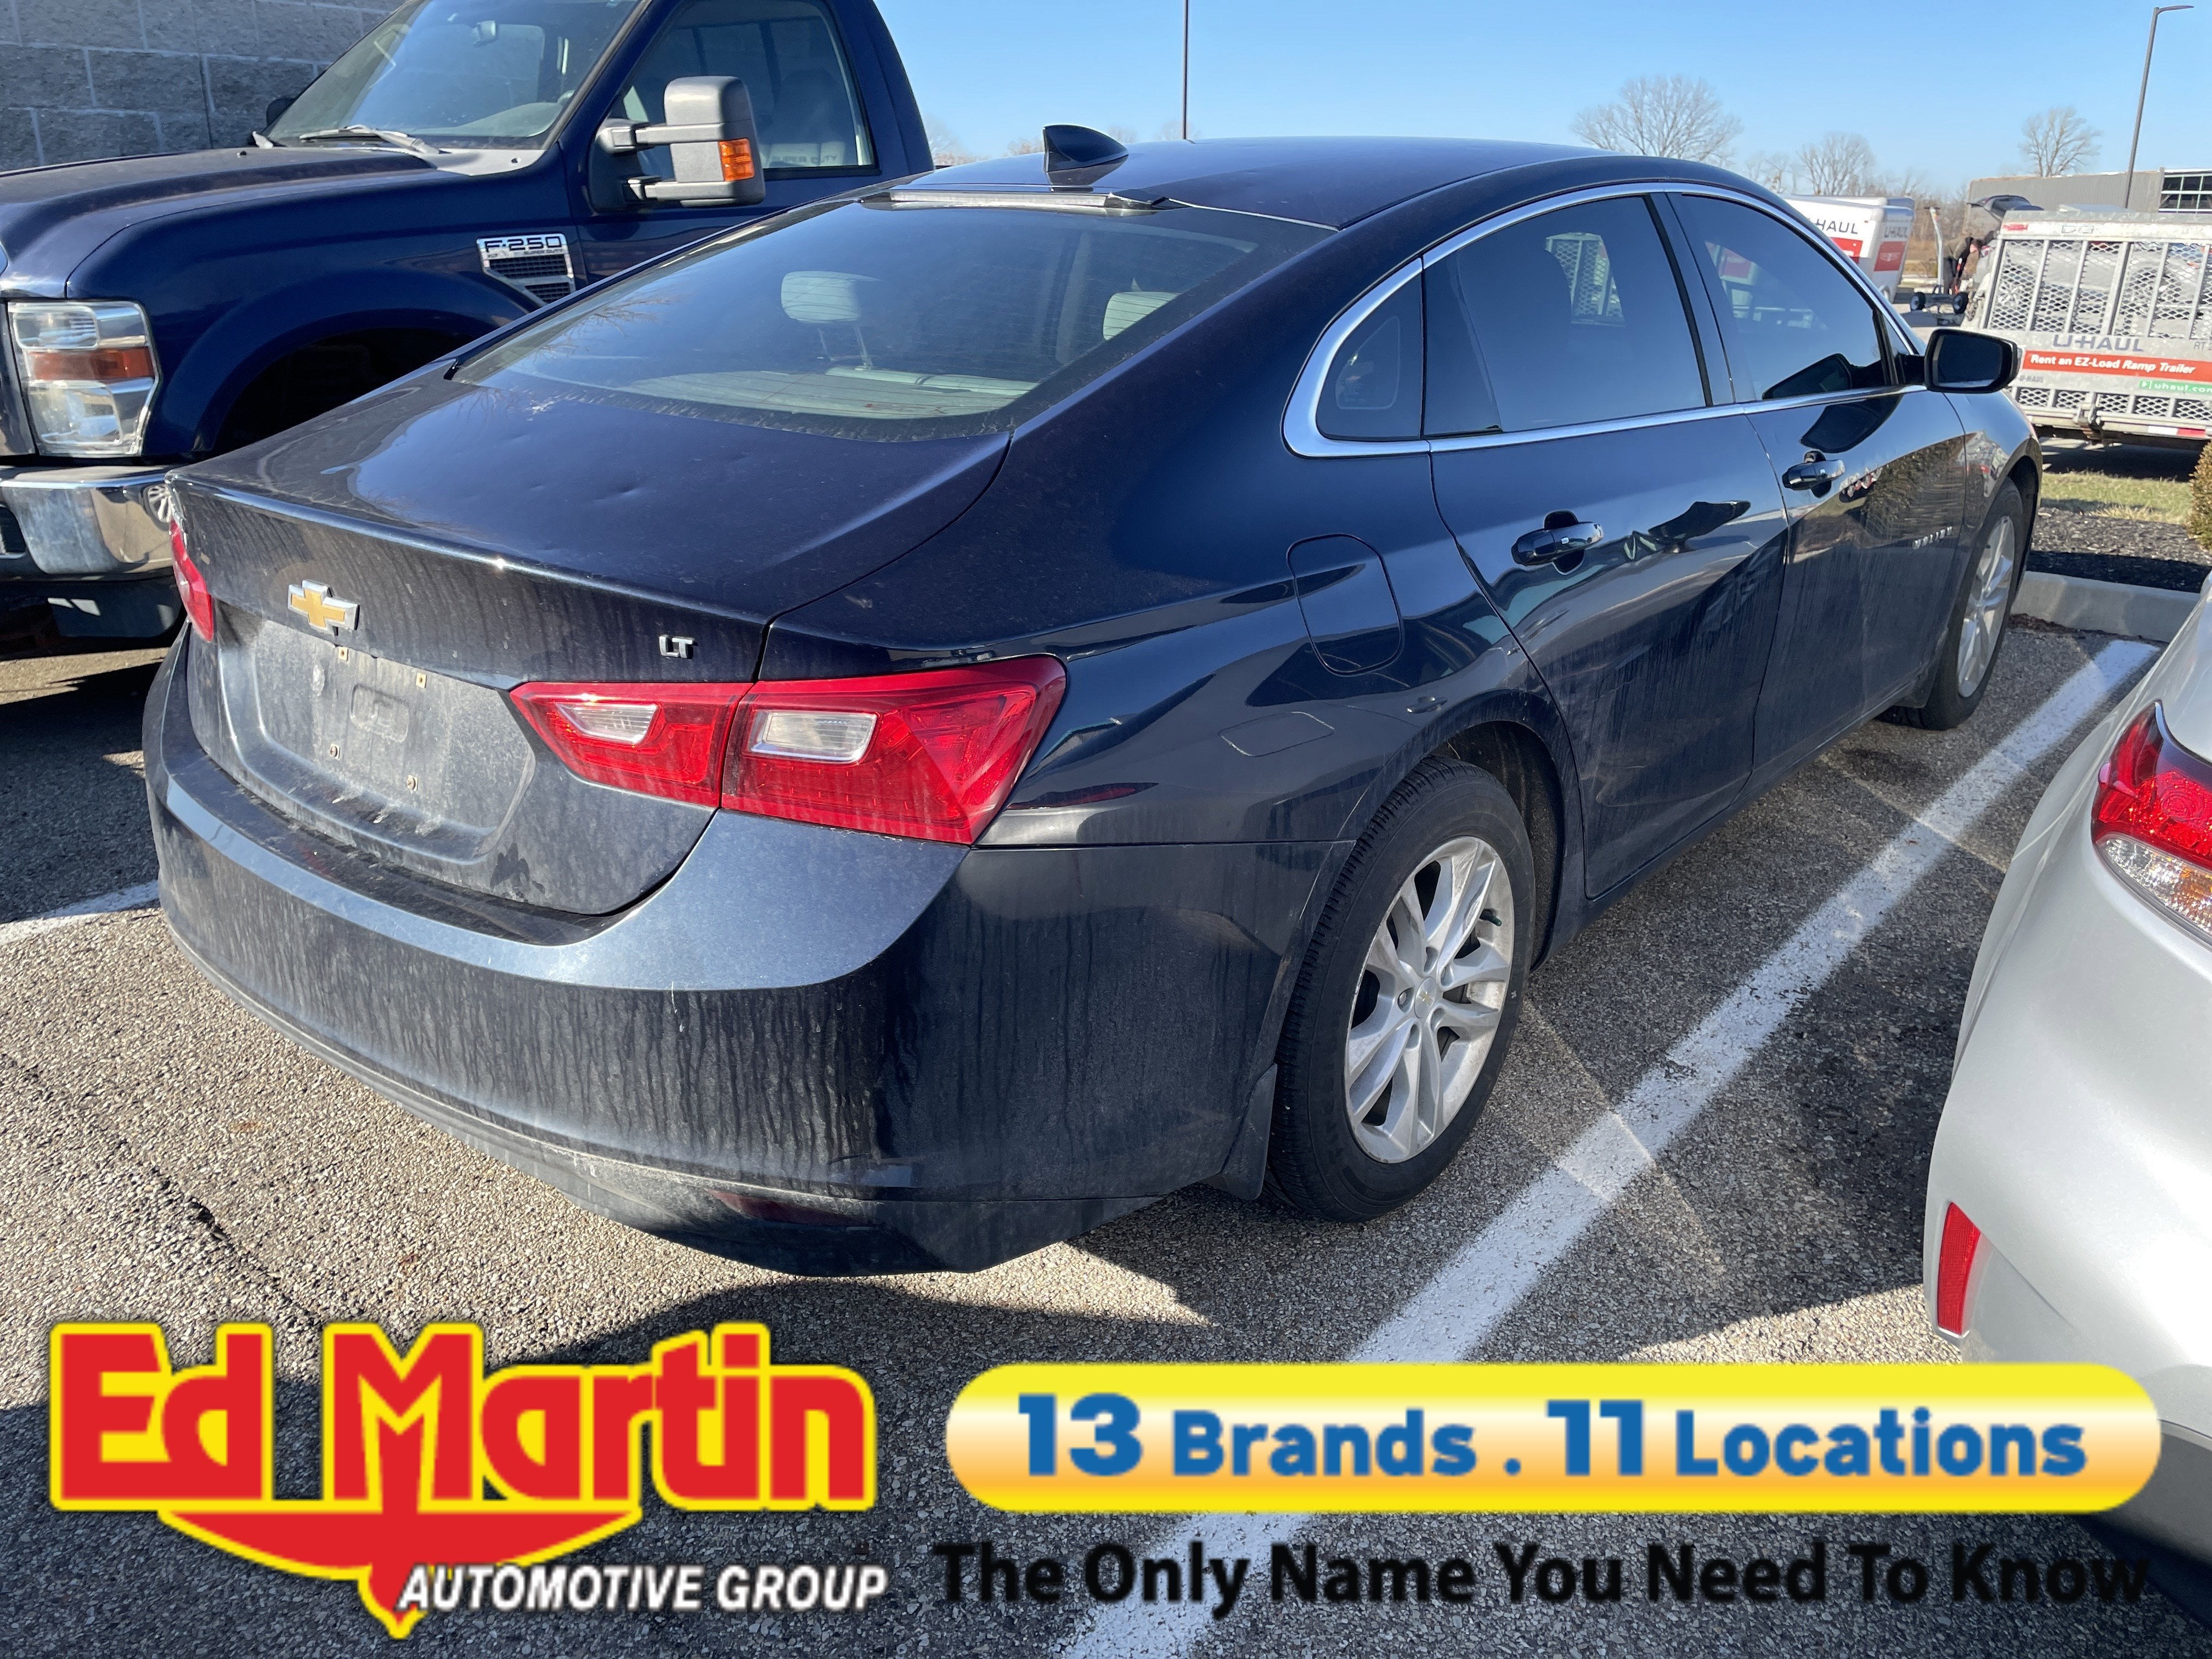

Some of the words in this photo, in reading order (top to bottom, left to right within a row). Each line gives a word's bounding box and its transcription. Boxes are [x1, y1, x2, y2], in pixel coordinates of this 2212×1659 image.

[484, 236, 562, 252] F-250
[2030, 354, 2057, 365] Rent
[2074, 357, 2120, 369] EZ-Load
[2122, 360, 2156, 373] Ramp
[2159, 362, 2196, 374] Trailer
[659, 635, 694, 658] LT
